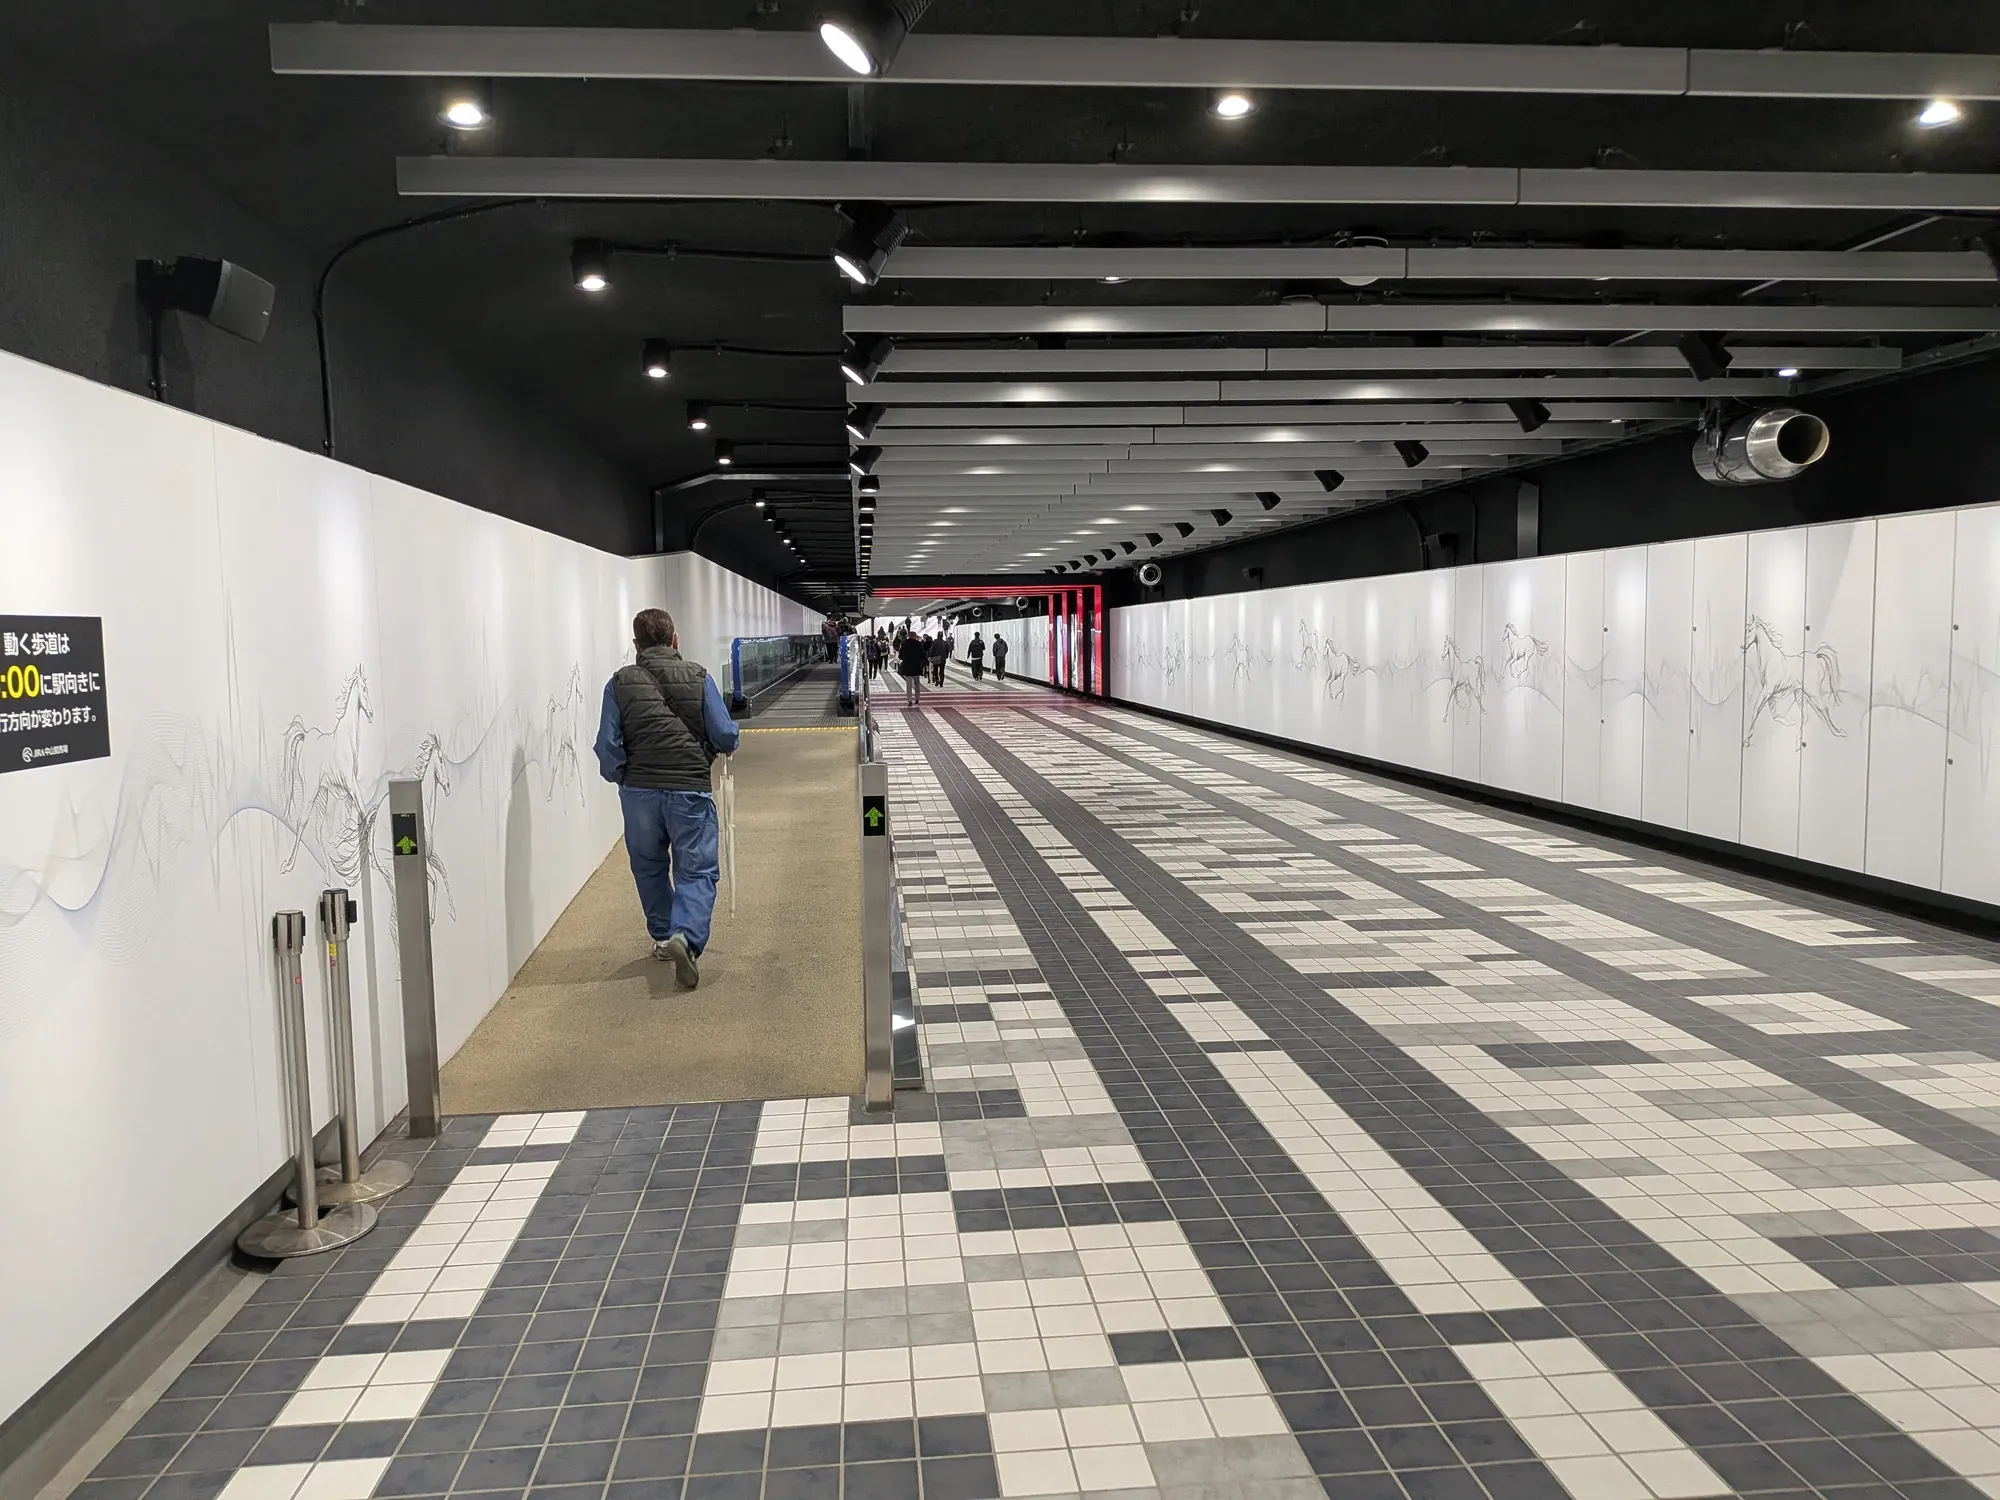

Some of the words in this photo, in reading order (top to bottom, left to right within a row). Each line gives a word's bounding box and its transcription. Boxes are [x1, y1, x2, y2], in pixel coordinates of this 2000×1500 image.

[3, 632, 70, 656] 動く歩道は
